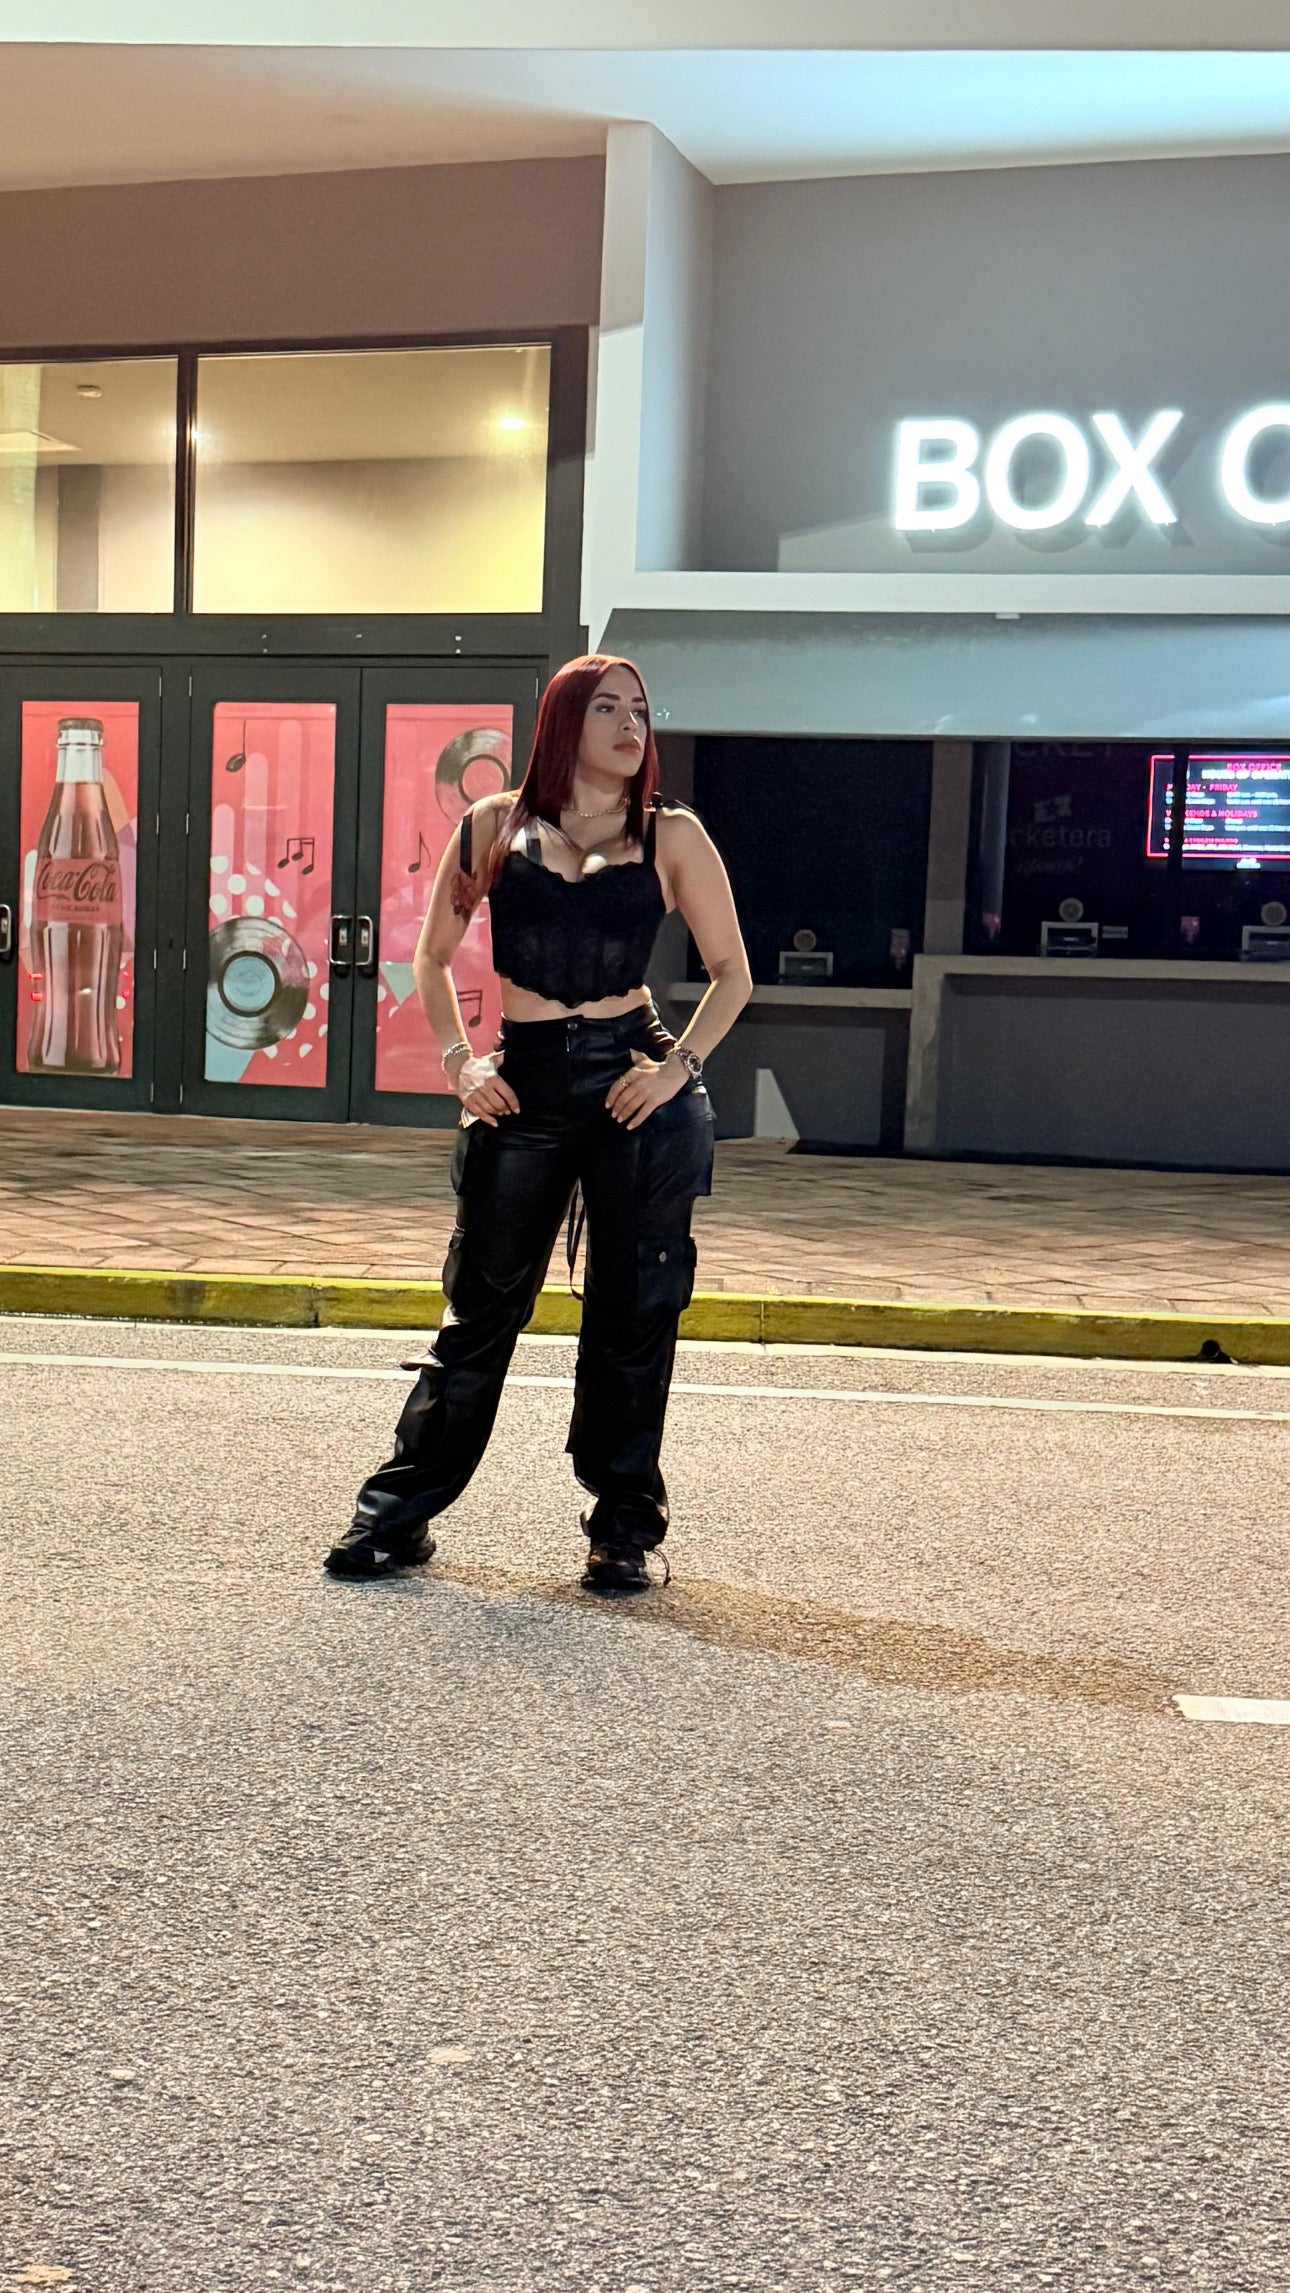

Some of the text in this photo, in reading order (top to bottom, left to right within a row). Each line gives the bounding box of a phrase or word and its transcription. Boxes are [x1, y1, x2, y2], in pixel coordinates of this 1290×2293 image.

[895, 411, 1184, 530] BOX
[1209, 783, 1238, 792] FRIDAY
[1218, 809, 1258, 818] HOLIDAYS
